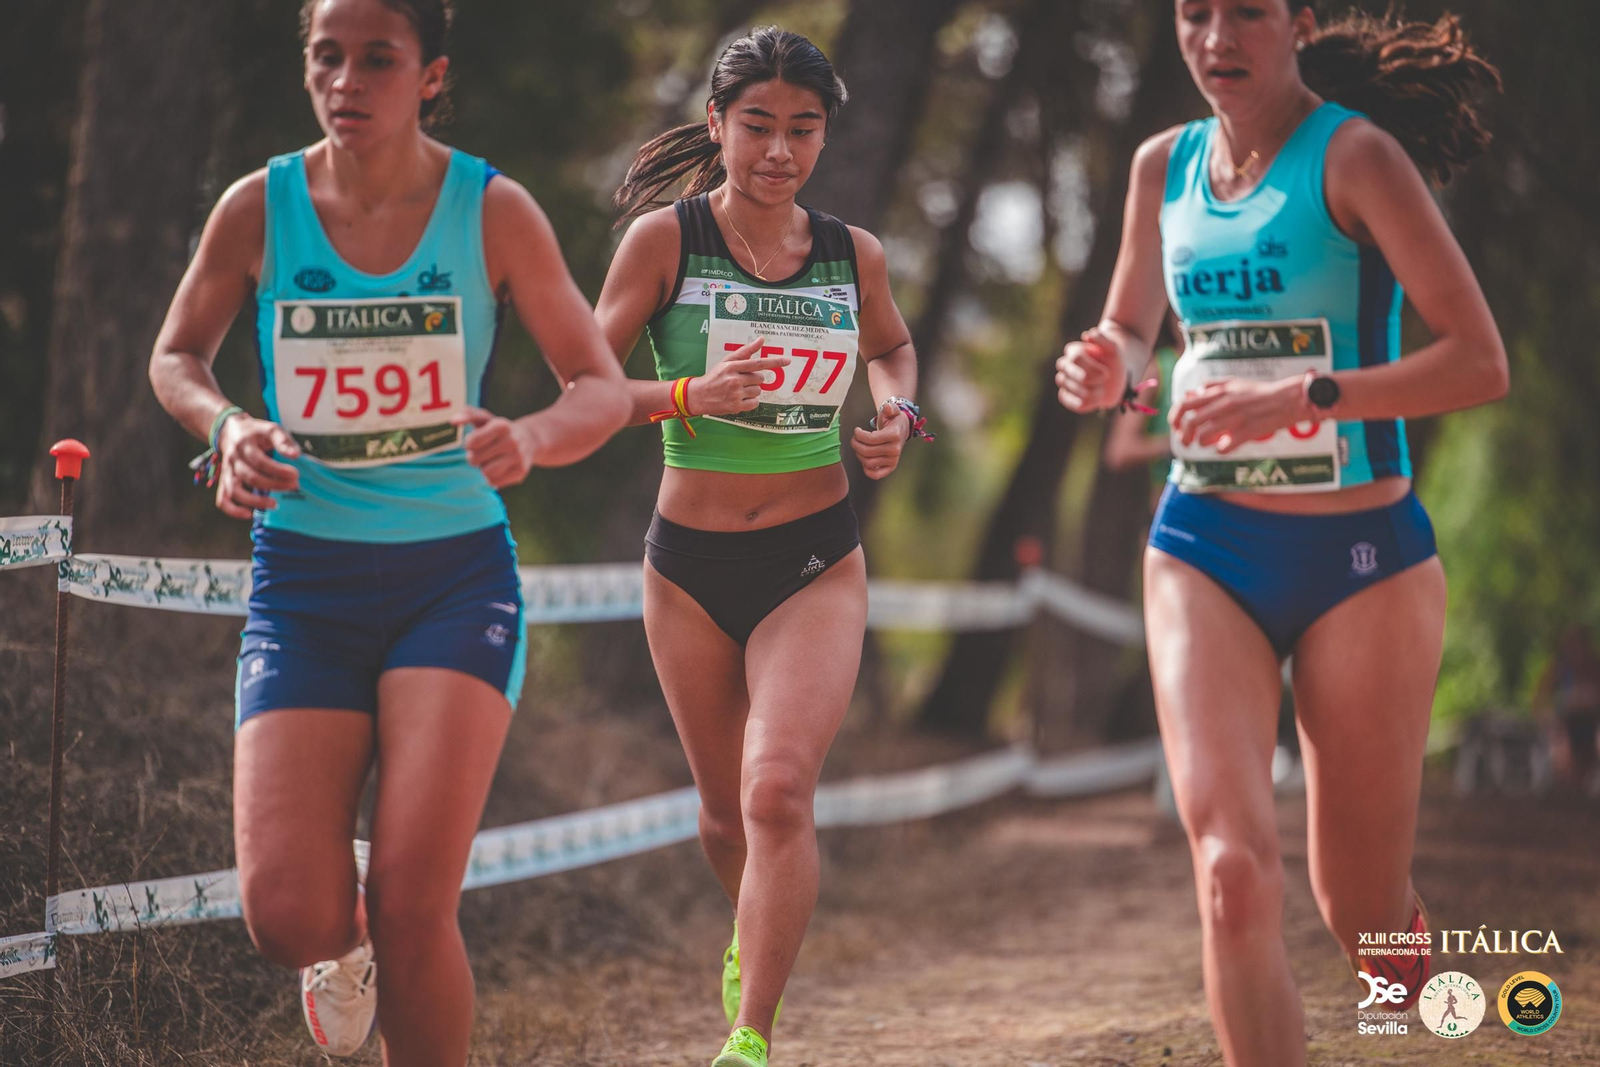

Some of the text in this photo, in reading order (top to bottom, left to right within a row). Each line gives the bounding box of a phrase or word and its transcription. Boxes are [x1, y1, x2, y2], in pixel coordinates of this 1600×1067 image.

[1173, 258, 1285, 301] nerja
[757, 295, 824, 318] ITÁLICA
[750, 322, 830, 335] BLANCA SANCHEZ MEDINA
[295, 359, 451, 419] 7591
